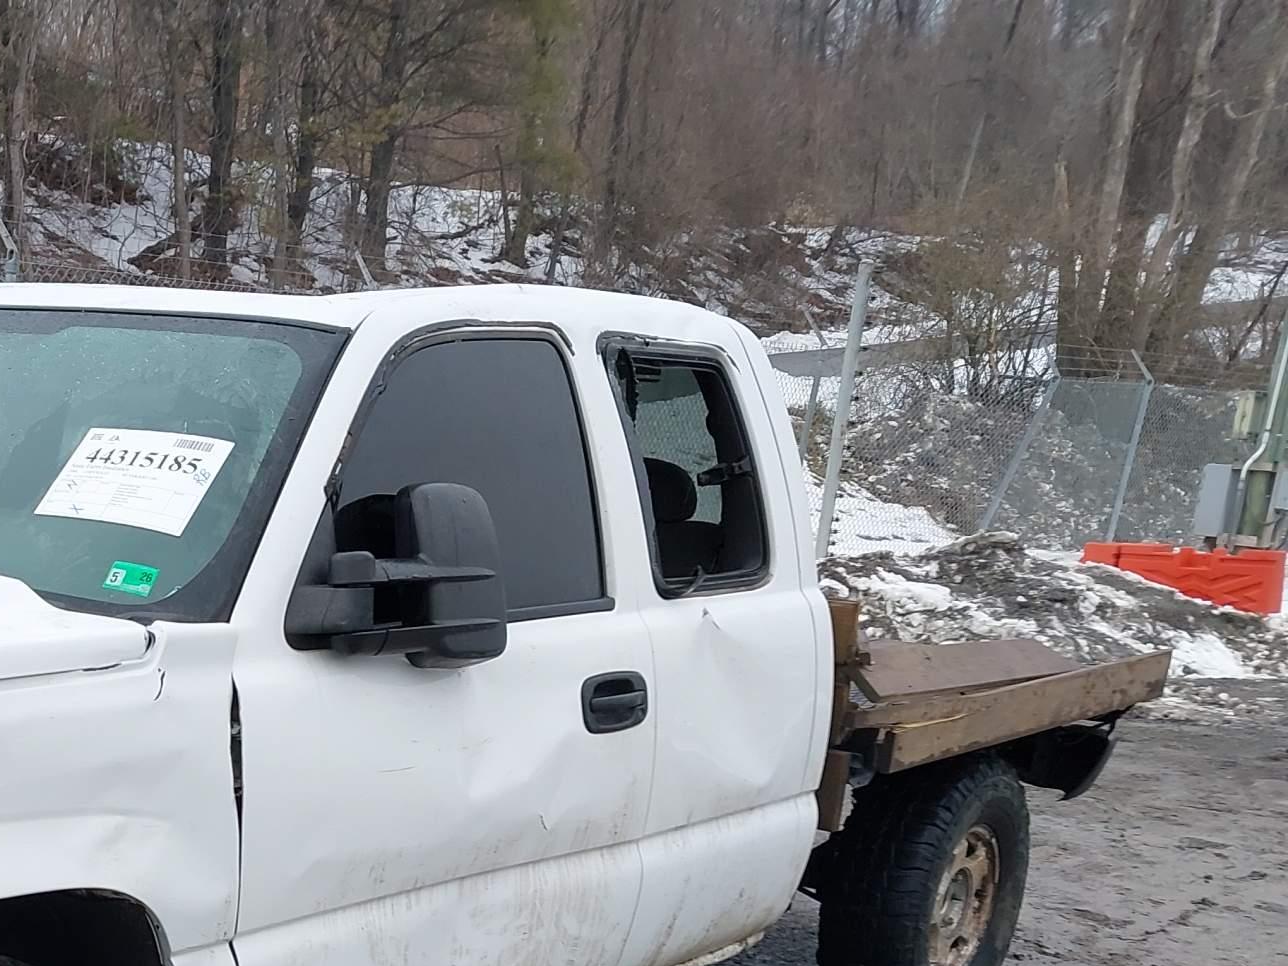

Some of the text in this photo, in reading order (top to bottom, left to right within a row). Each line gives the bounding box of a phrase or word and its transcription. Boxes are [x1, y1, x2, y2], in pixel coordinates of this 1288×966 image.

[86, 447, 202, 475] 44315185
[110, 571, 153, 583] 5 26
